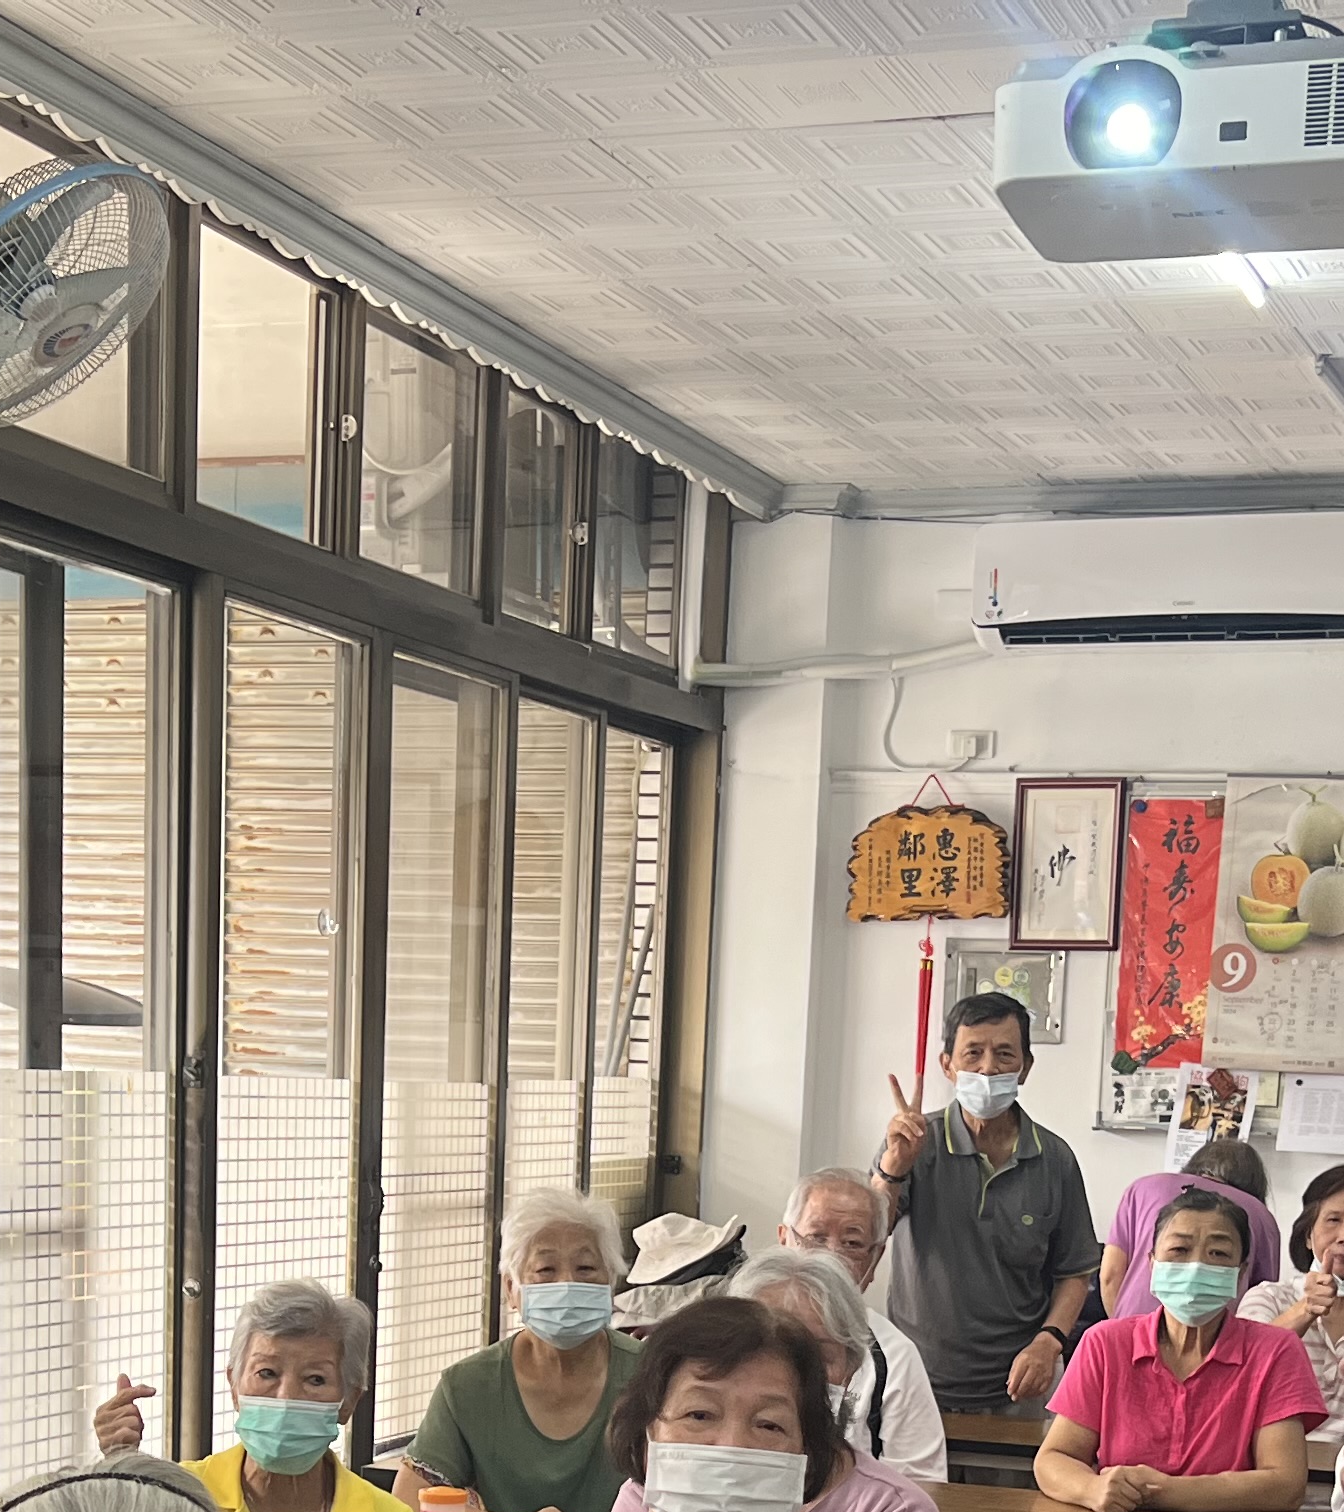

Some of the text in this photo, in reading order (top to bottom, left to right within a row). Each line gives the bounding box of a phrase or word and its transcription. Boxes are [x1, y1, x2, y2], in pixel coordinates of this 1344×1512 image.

[897, 830, 926, 898] 鄰里
[930, 828, 960, 898] 惠澤
[1222, 952, 1247, 987] 9
